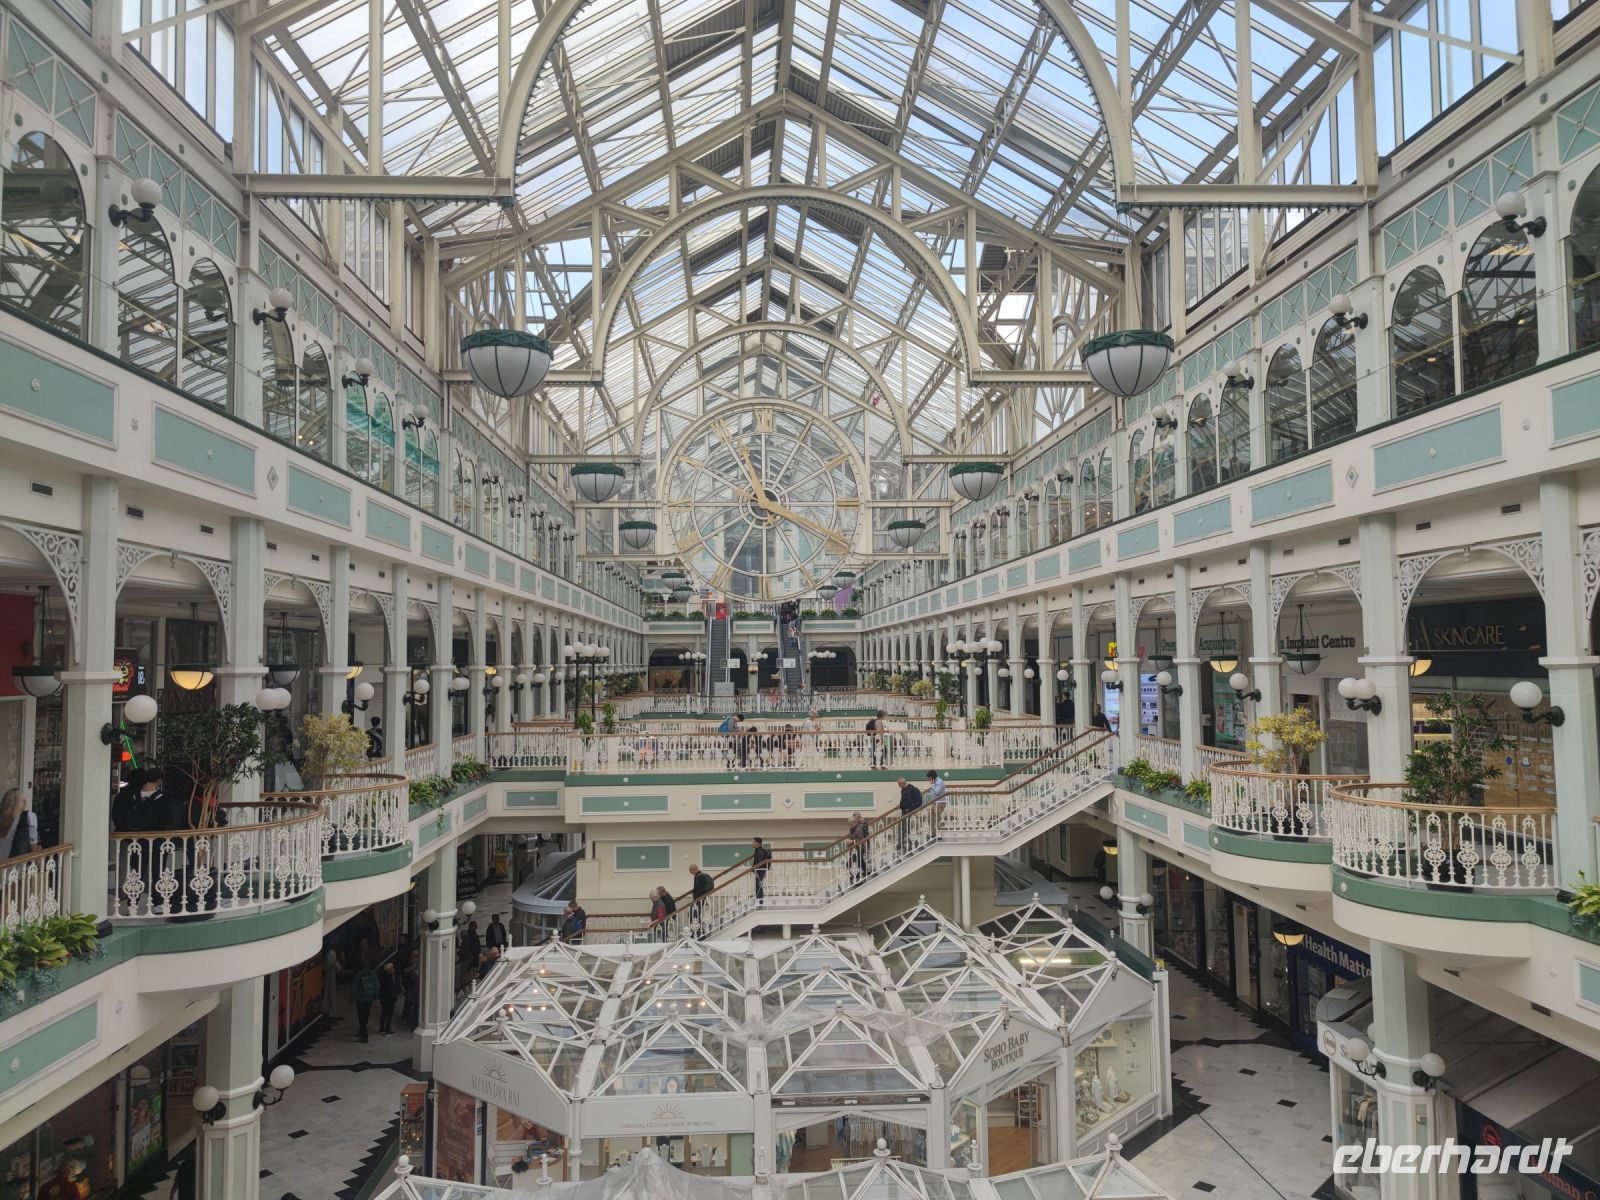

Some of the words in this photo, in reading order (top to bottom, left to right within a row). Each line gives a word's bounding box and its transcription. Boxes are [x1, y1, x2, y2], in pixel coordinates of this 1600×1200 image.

[1321, 634, 1356, 648] Centre
[1433, 625, 1505, 646] SKINCARE
[1304, 933, 1338, 964] Health
[984, 1042, 1007, 1063] SOHO
[1008, 1030, 1030, 1050] BABY
[991, 1046, 1024, 1070] BOUTIQUE
